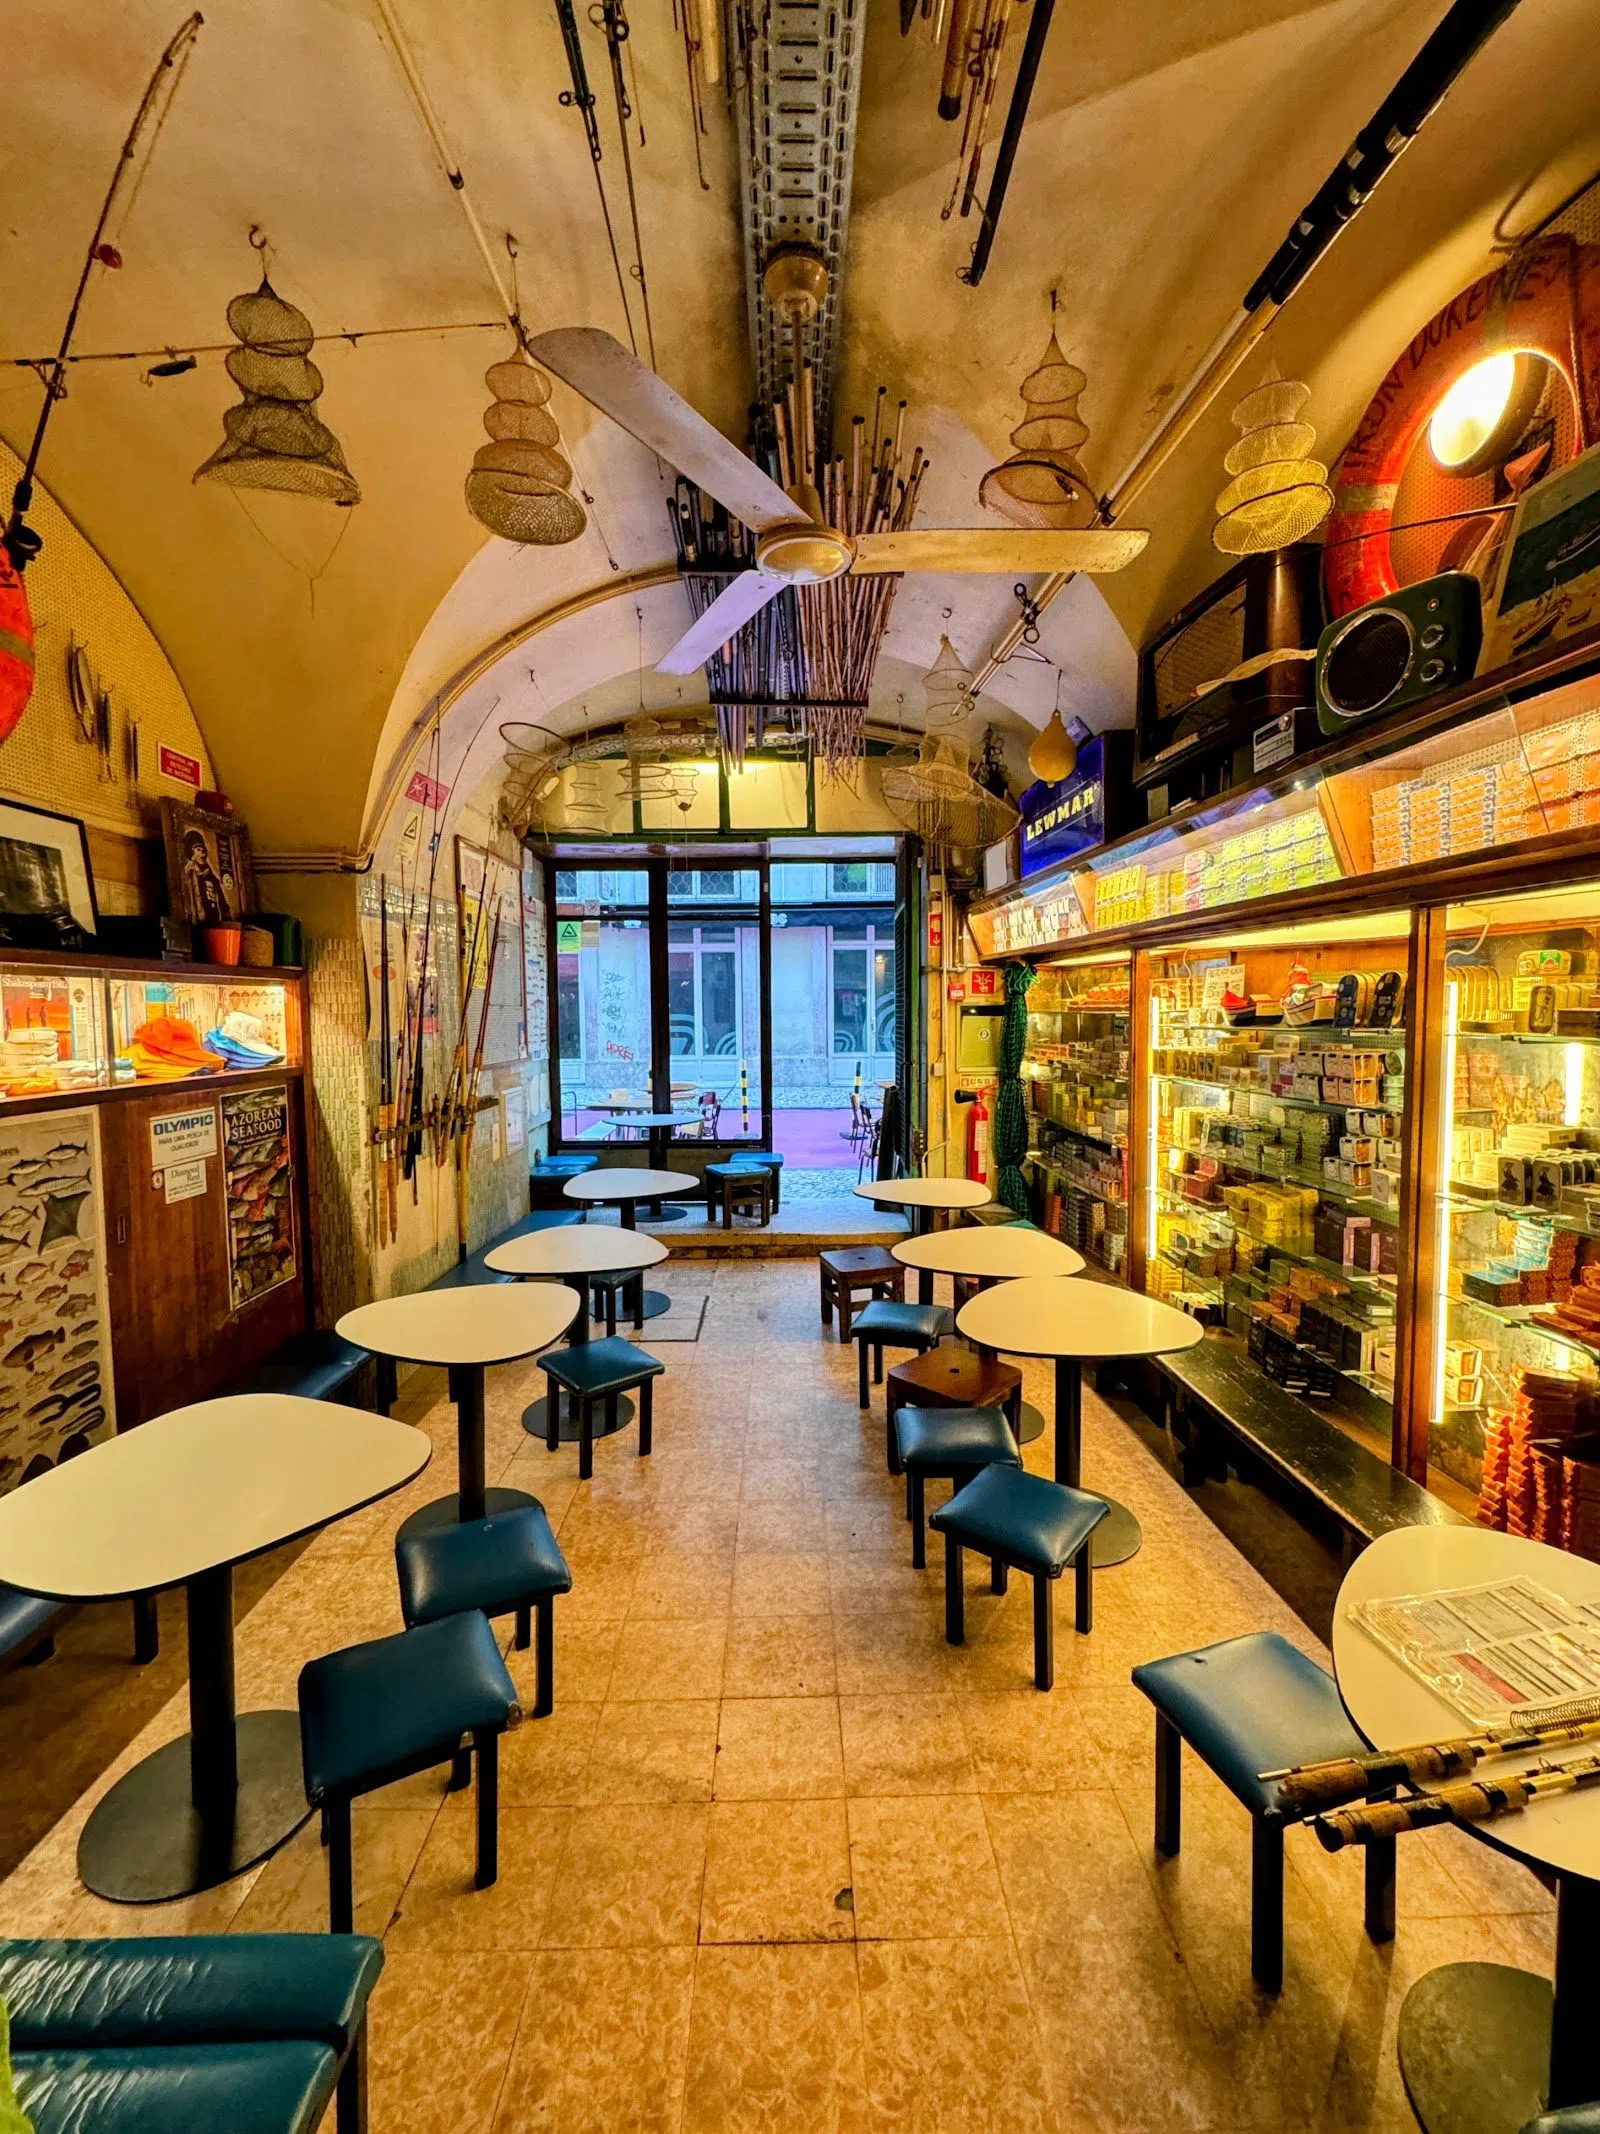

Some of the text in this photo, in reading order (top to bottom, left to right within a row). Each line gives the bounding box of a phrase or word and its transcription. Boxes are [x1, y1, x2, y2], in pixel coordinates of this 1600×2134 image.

[1026, 786, 1095, 841] LEWMAR
[153, 1114, 213, 1136] OLYMPIC
[230, 1108, 281, 1128] AZOREAN
[231, 1119, 282, 1140] SEAFOOD
